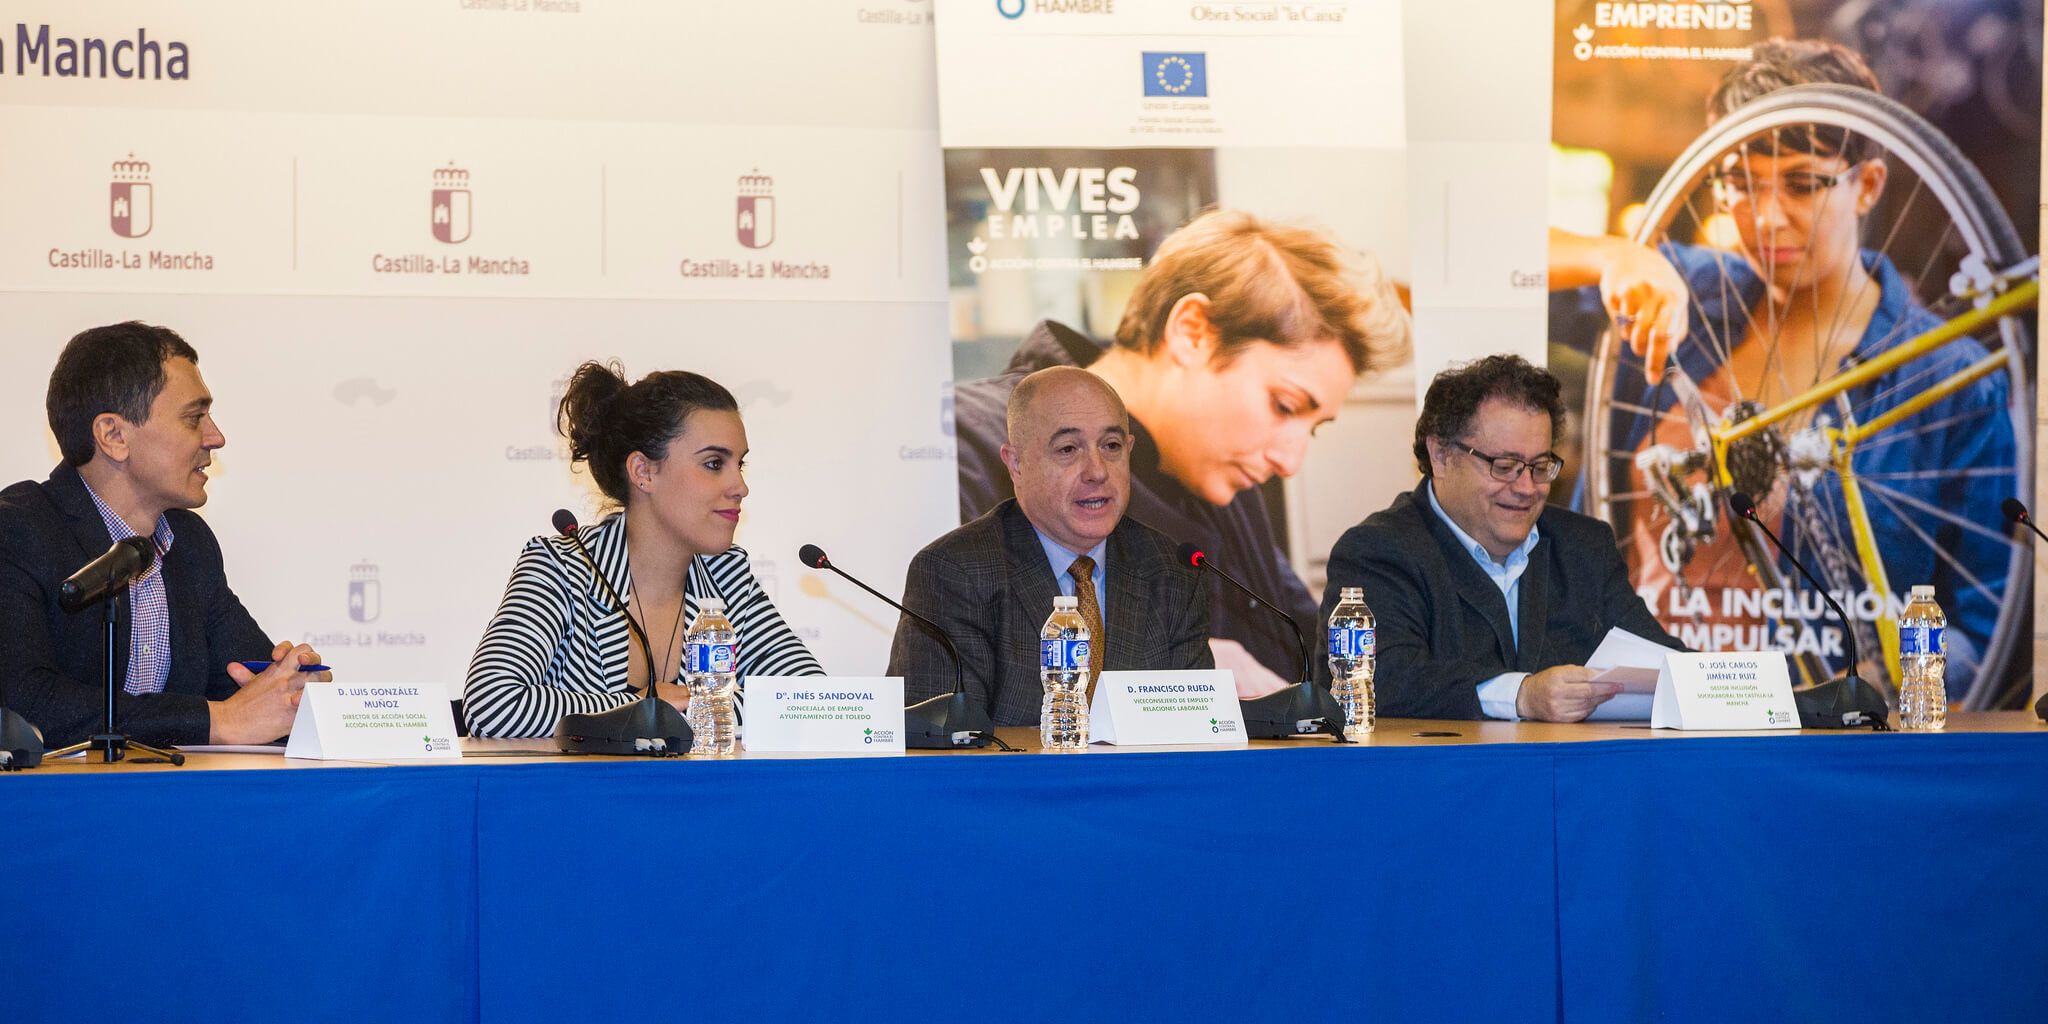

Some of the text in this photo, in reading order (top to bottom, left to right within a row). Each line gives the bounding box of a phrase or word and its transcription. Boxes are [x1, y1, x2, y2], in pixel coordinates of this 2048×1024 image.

[1035, 0, 1114, 14] HAMBRE
[1190, 6, 1230, 21] Obra
[1234, 6, 1279, 22] Social
[1595, 3, 1752, 30] EMPRENDE
[16, 23, 190, 81] Mancha
[979, 166, 1141, 214] VIVES
[988, 214, 1140, 240] EMPLEA
[48, 248, 213, 270] Castilla-La Mancha
[372, 253, 530, 275] Castilla-La Mancha
[680, 258, 831, 280] Castilla-La Mancha
[1669, 586, 1713, 617] LA
[1722, 584, 1912, 622] INCLUSIÓN
[1669, 622, 1844, 658] IMPULSAR
[1699, 662, 1708, 670] D.
[1709, 661, 1727, 670] JOSÉ
[1706, 672, 1757, 681] JIMÉNEZ RUIZ
[338, 686, 419, 696] D. LUIS GONZÁLEZ
[793, 690, 815, 700] INÉS
[818, 692, 874, 700] SANDOVAL
[1127, 684, 1215, 694] D. FRANCISCO RUEDA
[364, 698, 400, 709] MUÑOZ
